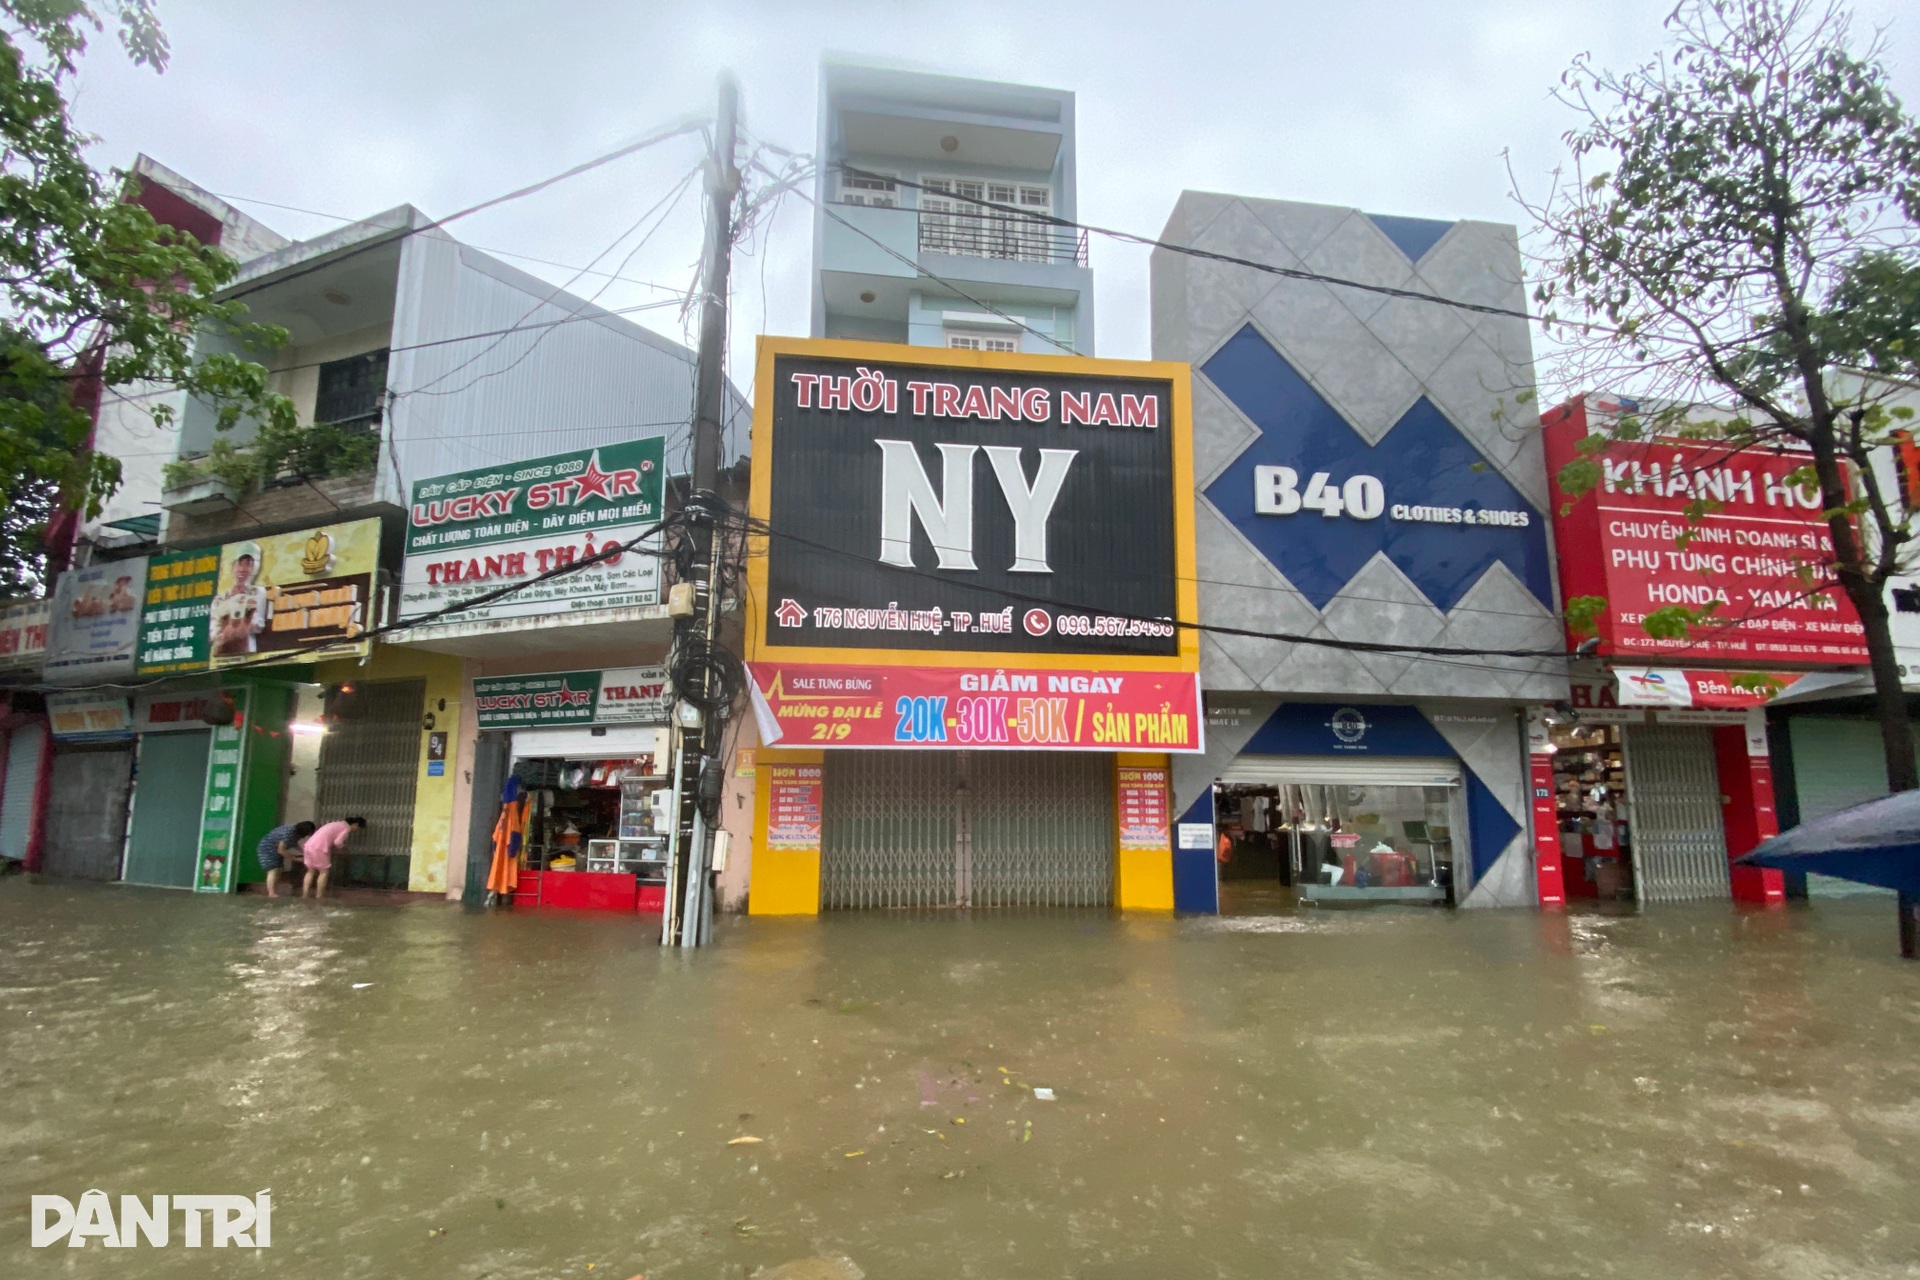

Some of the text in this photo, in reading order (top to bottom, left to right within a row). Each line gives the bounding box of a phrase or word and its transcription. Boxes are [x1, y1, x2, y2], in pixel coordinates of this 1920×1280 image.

[791, 367, 1159, 428] THỜI TRANG NAM
[513, 465, 553, 482] SINCE
[554, 460, 584, 475] 1988
[1602, 453, 1823, 510] KHÁNH HO
[412, 487, 521, 527] LUCKY
[874, 438, 1080, 574] NY
[1254, 465, 1385, 520] B40
[1390, 503, 1463, 524] CLOTHES
[1477, 509, 1530, 528] SHOES
[474, 523, 501, 538] TOÀN
[543, 513, 565, 528] DÂY
[569, 509, 595, 525] ĐIỆN
[597, 507, 619, 522] MỌI
[622, 500, 651, 518] MIỀN
[1609, 520, 1684, 540] CHUYÊN
[1688, 526, 1731, 544] KINH
[1735, 530, 1797, 549] DOANH
[426, 552, 526, 585] THANH
[1611, 548, 1797, 578] PHỤ TÙNG CHÍNH
[1647, 583, 1731, 606] HONDA
[814, 607, 843, 628] 176
[844, 601, 908, 630] NGUYỄN
[910, 606, 942, 635] HUỆ
[1620, 613, 1636, 623] XE
[1805, 622, 1819, 632] XE
[793, 678, 815, 690] SALE
[959, 669, 1124, 694] GIẢM NGAY
[1697, 680, 1727, 694] Bên
[475, 693, 534, 710] LUCKY
[778, 702, 884, 721] MỪNG ĐẠI LỄ
[811, 723, 851, 740] 2/9
[1092, 702, 1130, 743] SẢN
[1136, 702, 1188, 745] PHẨM
